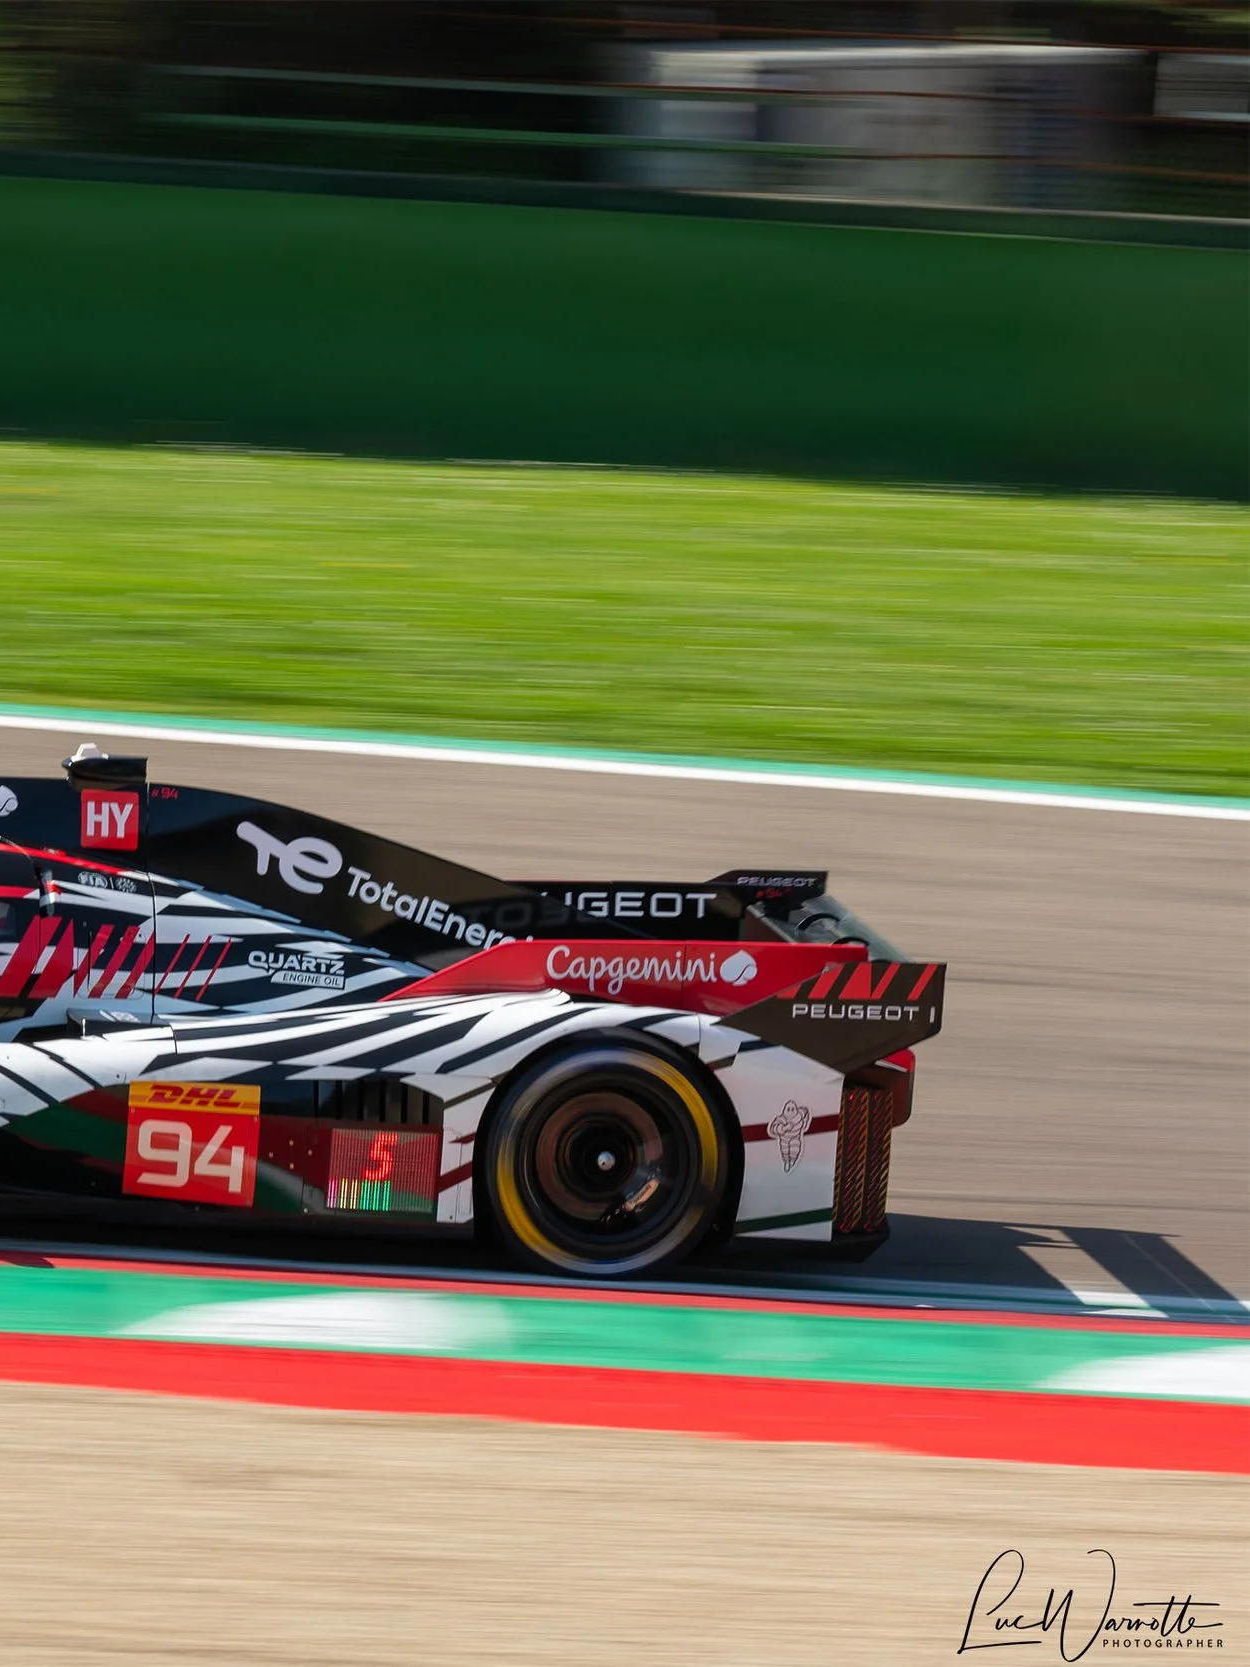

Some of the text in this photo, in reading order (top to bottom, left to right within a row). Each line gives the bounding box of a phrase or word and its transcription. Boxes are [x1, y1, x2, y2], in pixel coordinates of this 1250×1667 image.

[86, 800, 134, 839] HY
[736, 876, 818, 888] PEUGEOT
[248, 950, 346, 975] QUARTZ
[546, 944, 718, 995] Capgemini
[282, 972, 341, 986] ENGINE OIL
[791, 1003, 920, 1021] PEUGEOT
[148, 1084, 244, 1108] DHL
[136, 1118, 246, 1194] 94
[362, 1131, 399, 1182] 5
